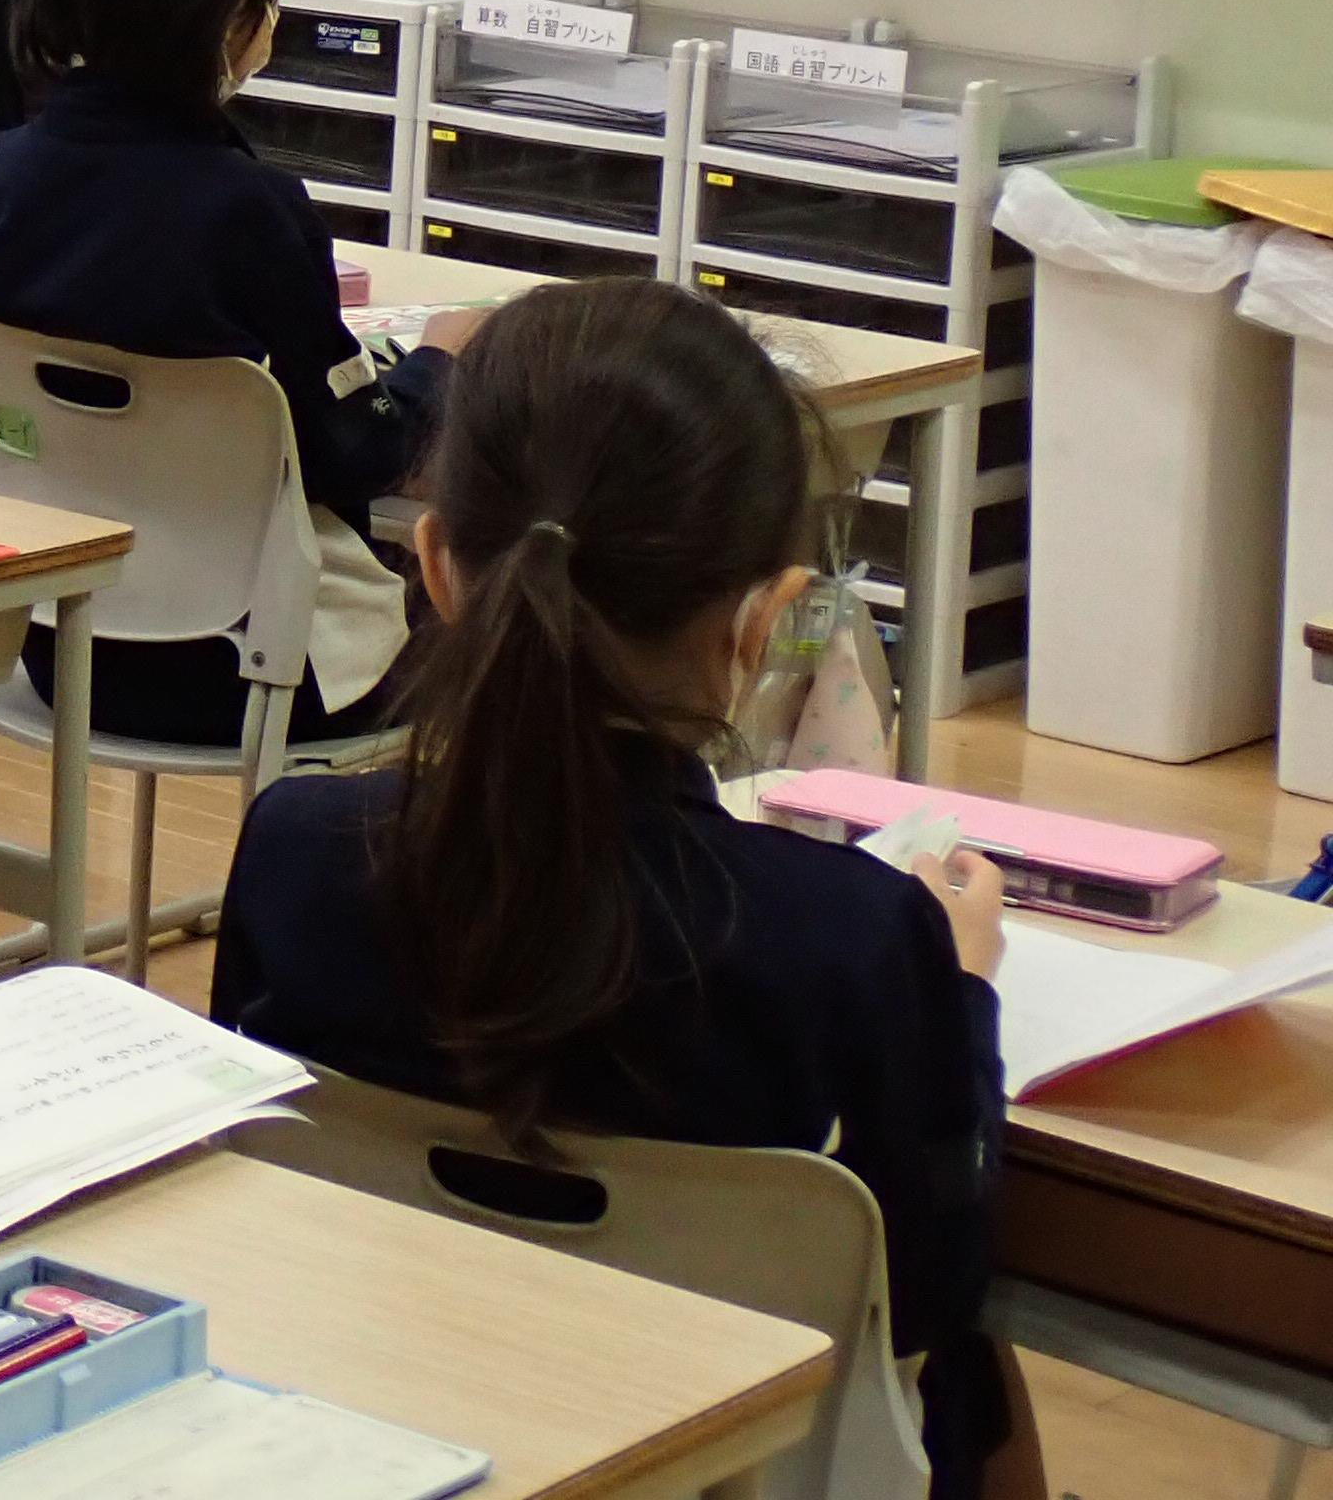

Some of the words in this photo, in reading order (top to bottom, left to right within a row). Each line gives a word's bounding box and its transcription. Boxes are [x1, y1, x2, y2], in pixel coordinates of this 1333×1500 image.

[477, 7, 509, 28] 算数
[527, 16, 615, 46] 自習プリント
[747, 52, 780, 73] 国語
[792, 58, 887, 86] 自習プリント
